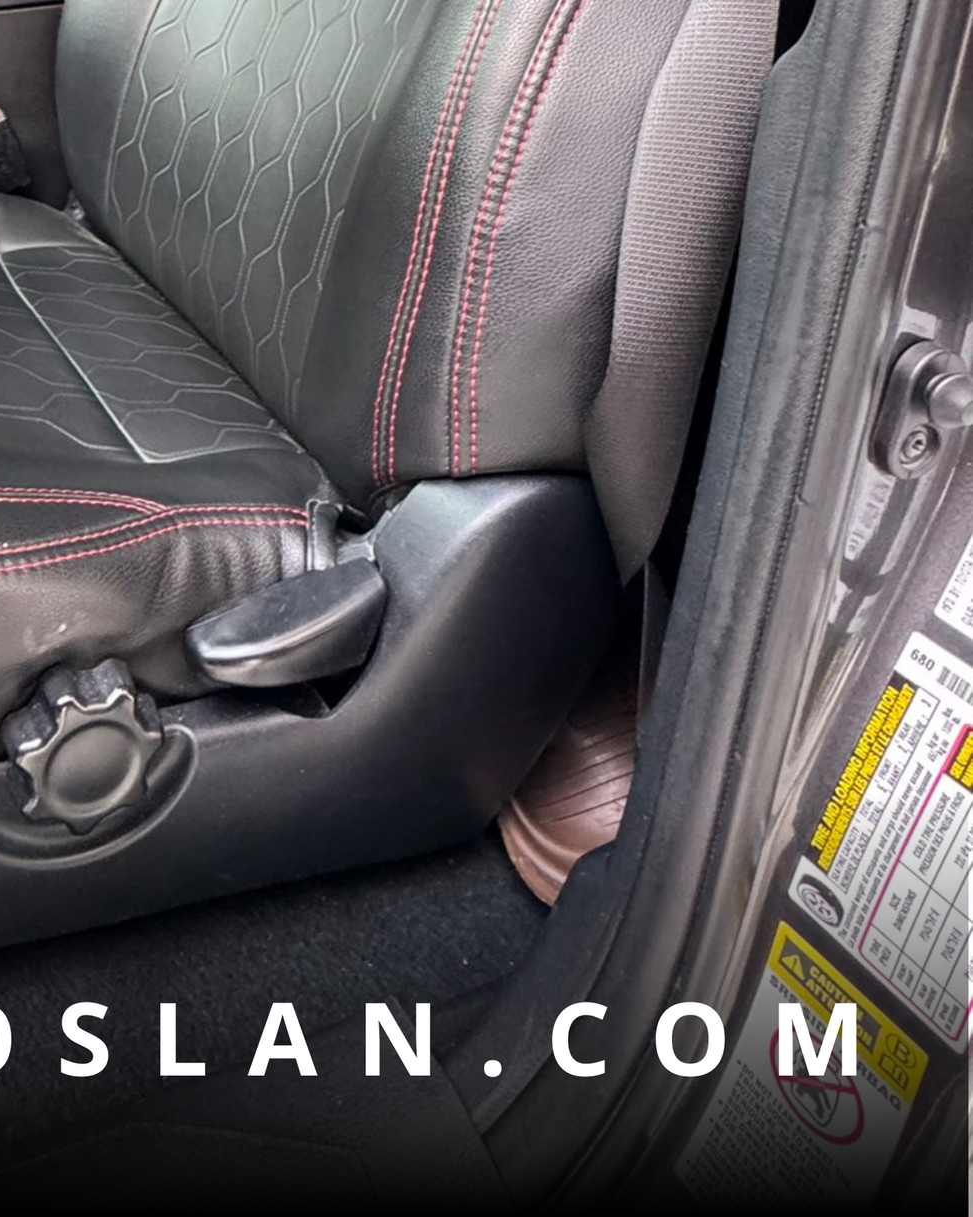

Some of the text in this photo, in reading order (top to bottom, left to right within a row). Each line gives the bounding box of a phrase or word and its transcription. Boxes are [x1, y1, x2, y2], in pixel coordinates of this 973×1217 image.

[910, 648, 935, 672] 680
[809, 684, 899, 850] TIRE AND LOADING INFORMATION
[817, 682, 915, 871] RENSEIGNEMENTS SUR LES PNEUS ET LE CHARGEMENT
[717, 1111, 736, 1134] FOR
[721, 1103, 739, 1123] SEE
[725, 1095, 746, 1120] SIDE
[745, 1118, 778, 1156] AIRBAG
[729, 1087, 767, 1130] SERIOUS
[766, 1129, 797, 1164] INJURY
[733, 1079, 778, 1130] POTENTIAL
[777, 1129, 807, 1164] DEATH
[736, 1071, 766, 1103] FRONT
[765, 1102, 791, 1132] DOOR
[803, 1146, 832, 1179] AVOID
[753, 1077, 773, 1099] NOT
[771, 1098, 795, 1124] LEAN
[795, 1124, 834, 1167] AGAINST
